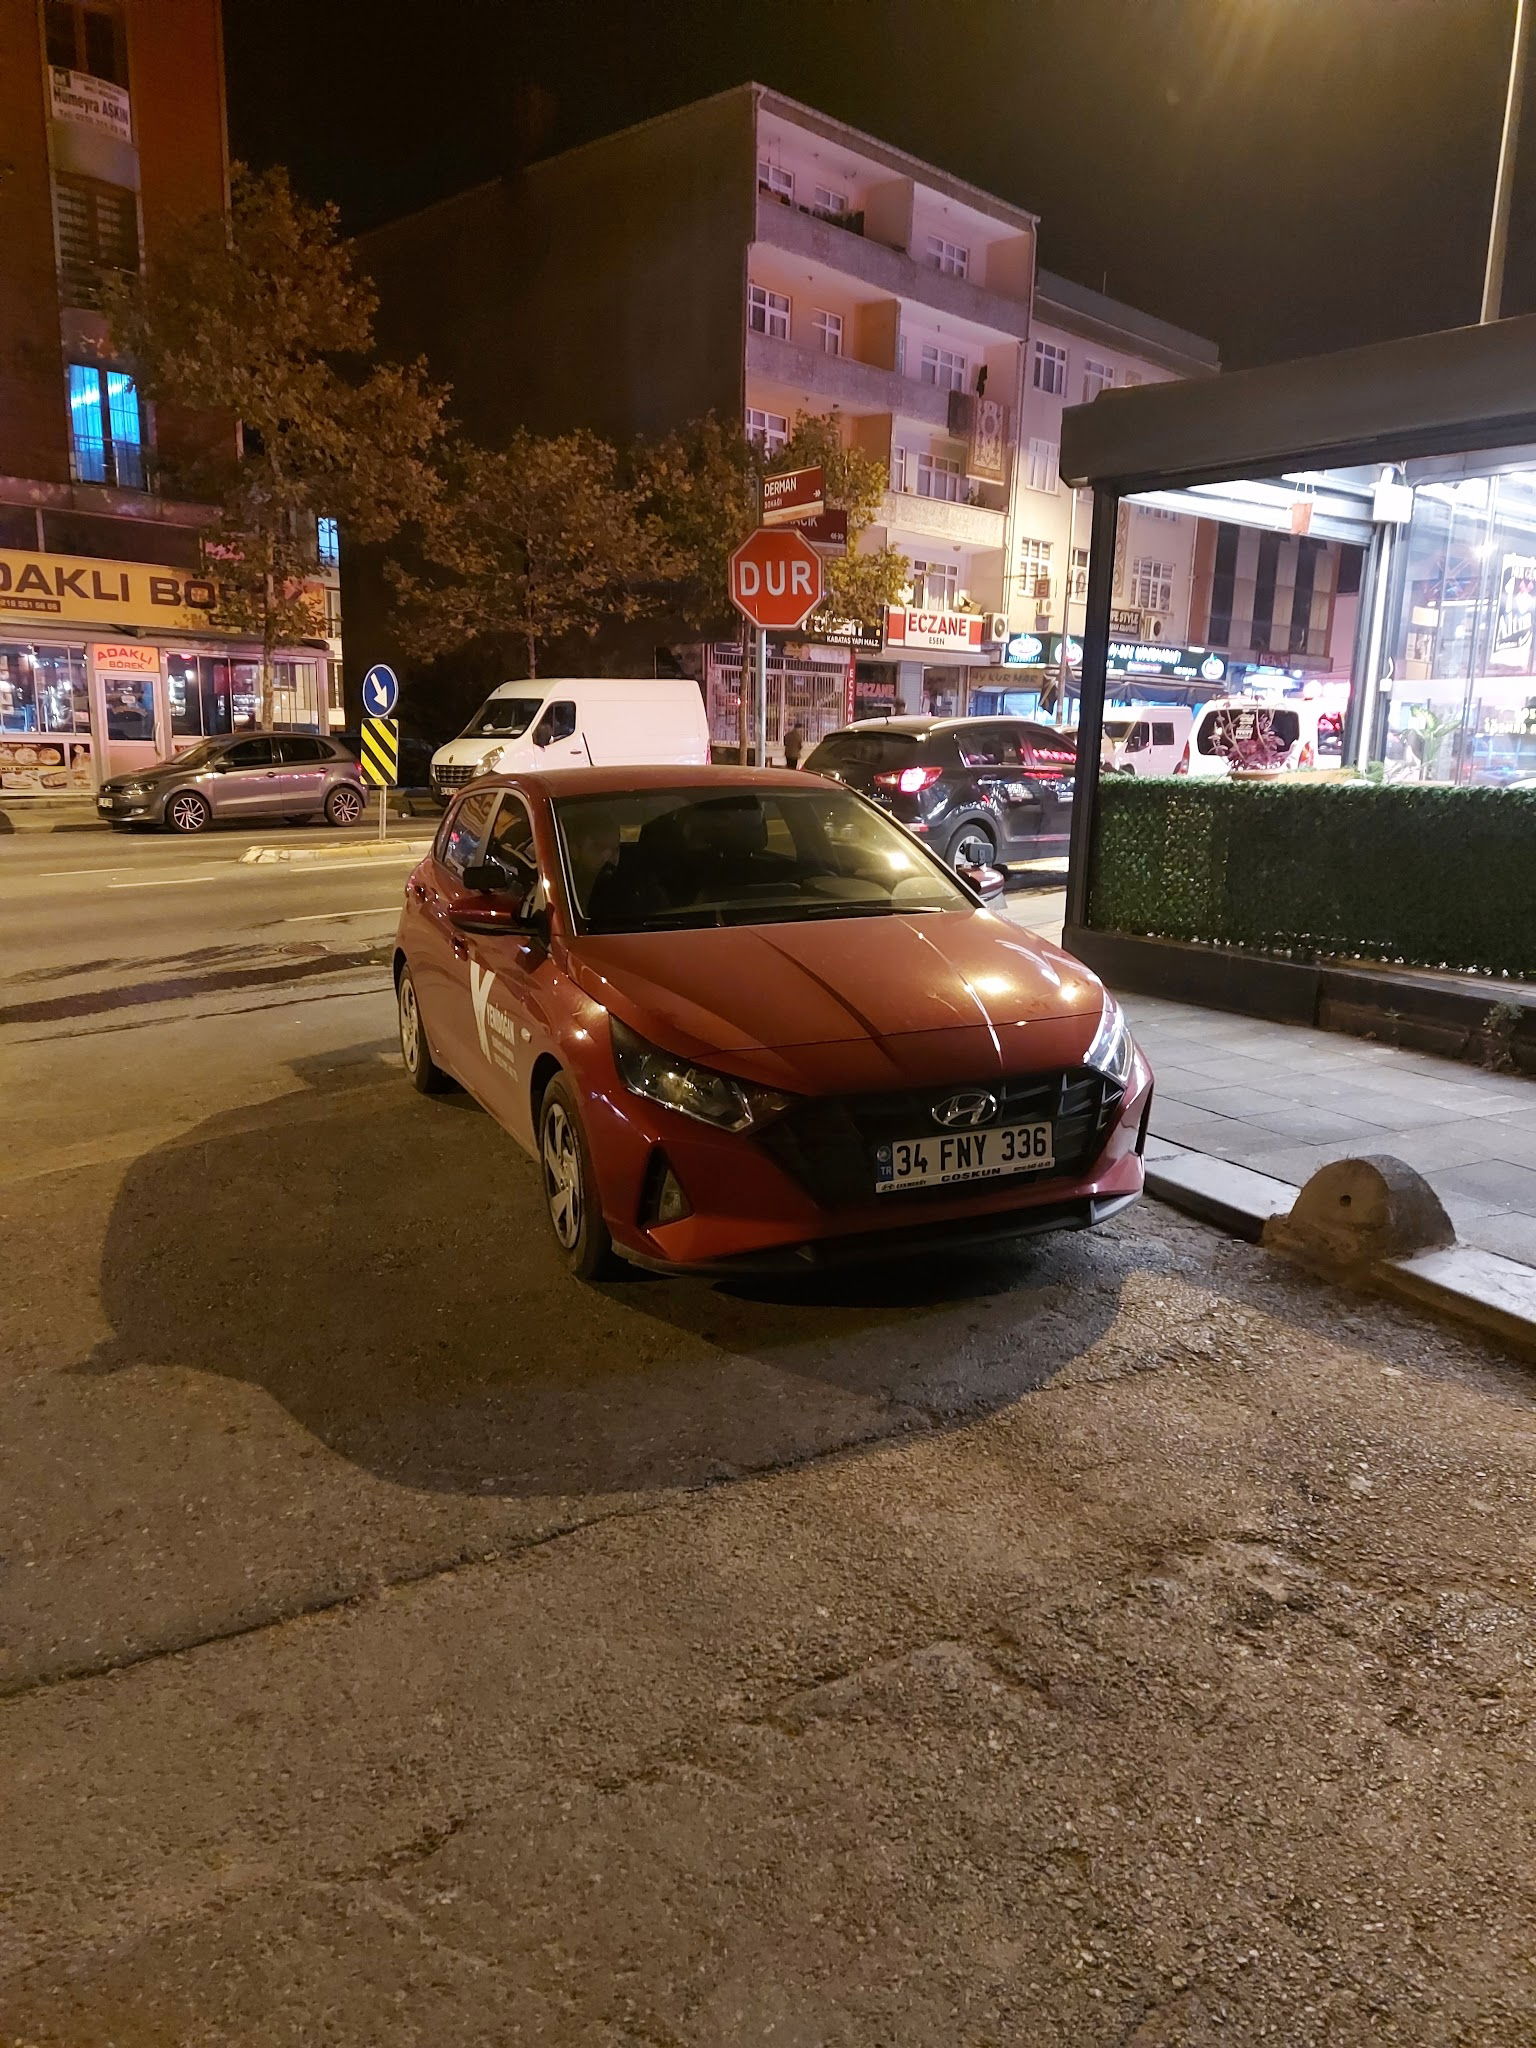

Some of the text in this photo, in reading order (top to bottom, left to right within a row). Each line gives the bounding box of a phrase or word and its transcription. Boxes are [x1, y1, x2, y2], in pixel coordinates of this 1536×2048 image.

[764, 476, 797, 498] DERMAN
[740, 560, 813, 597] DUR
[908, 612, 967, 637] ECZANE
[851, 637, 864, 645] YAPI
[928, 636, 945, 645] ESEN
[97, 647, 153, 665] ADAKLI
[109, 659, 145, 670] BÖREK
[856, 682, 895, 698] ECZANE
[896, 1126, 1047, 1176] 34 FNY 336
[880, 1165, 892, 1176] TR
